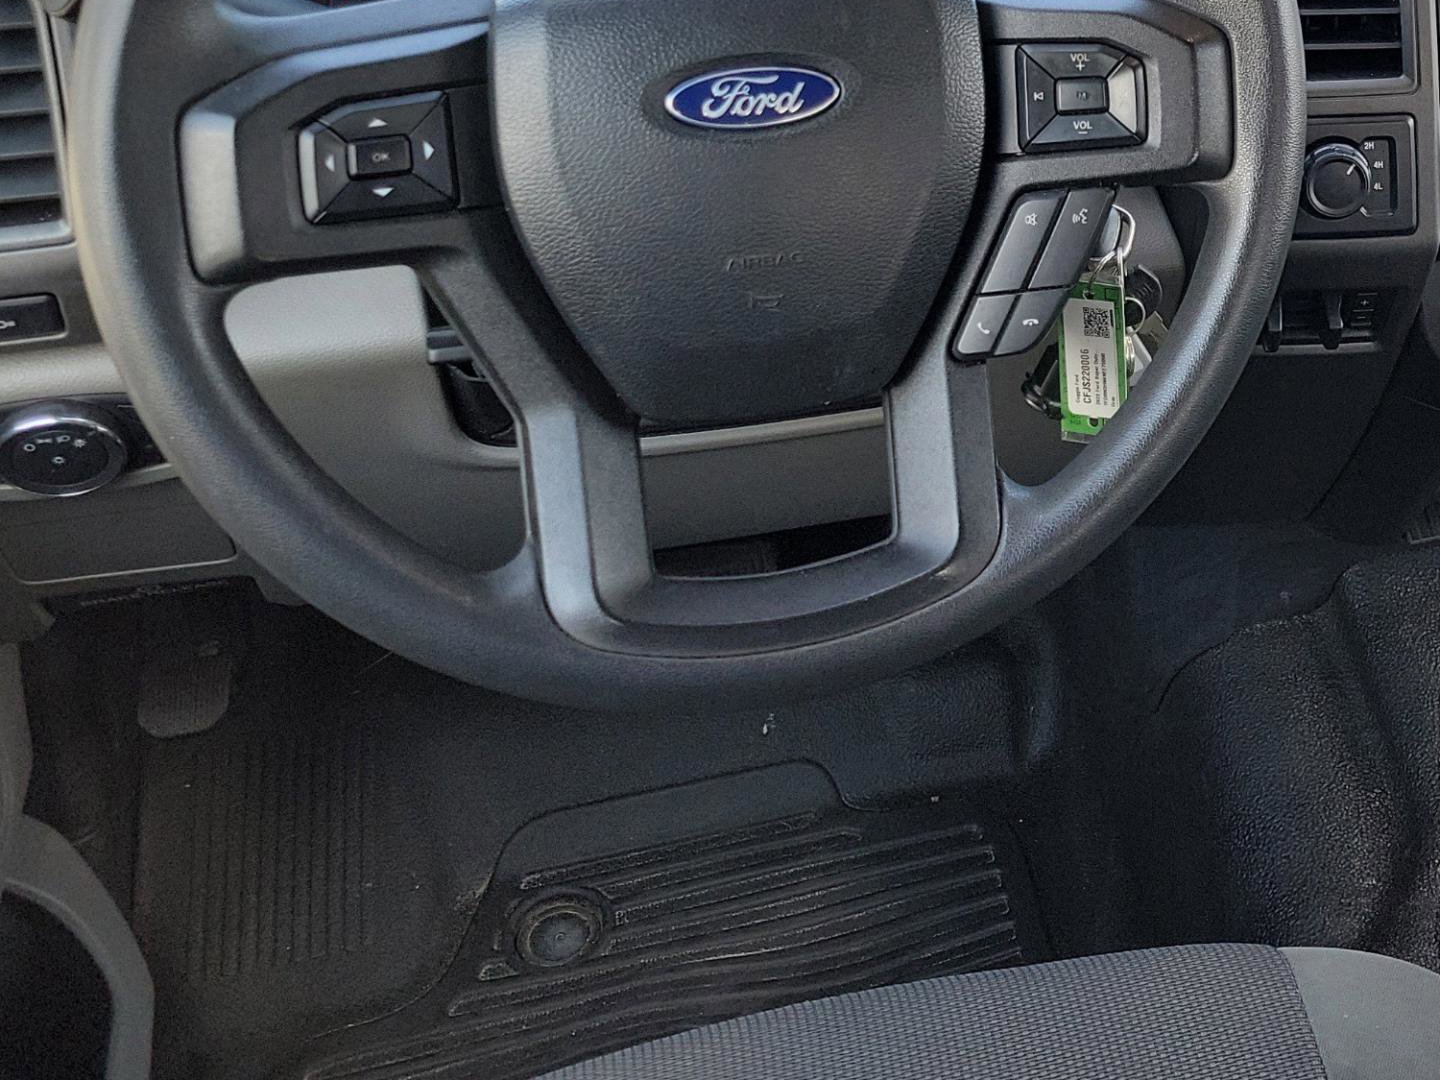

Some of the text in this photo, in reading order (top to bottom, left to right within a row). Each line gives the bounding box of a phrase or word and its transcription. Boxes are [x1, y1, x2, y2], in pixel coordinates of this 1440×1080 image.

[1070, 53, 1090, 62] VOL
[702, 74, 805, 119] Ford
[1073, 121, 1093, 130] VOL
[1364, 142, 1375, 150] 2H
[372, 152, 390, 162] OK
[1373, 161, 1384, 169] 4H
[1081, 348, 1092, 404] CFJS220006
